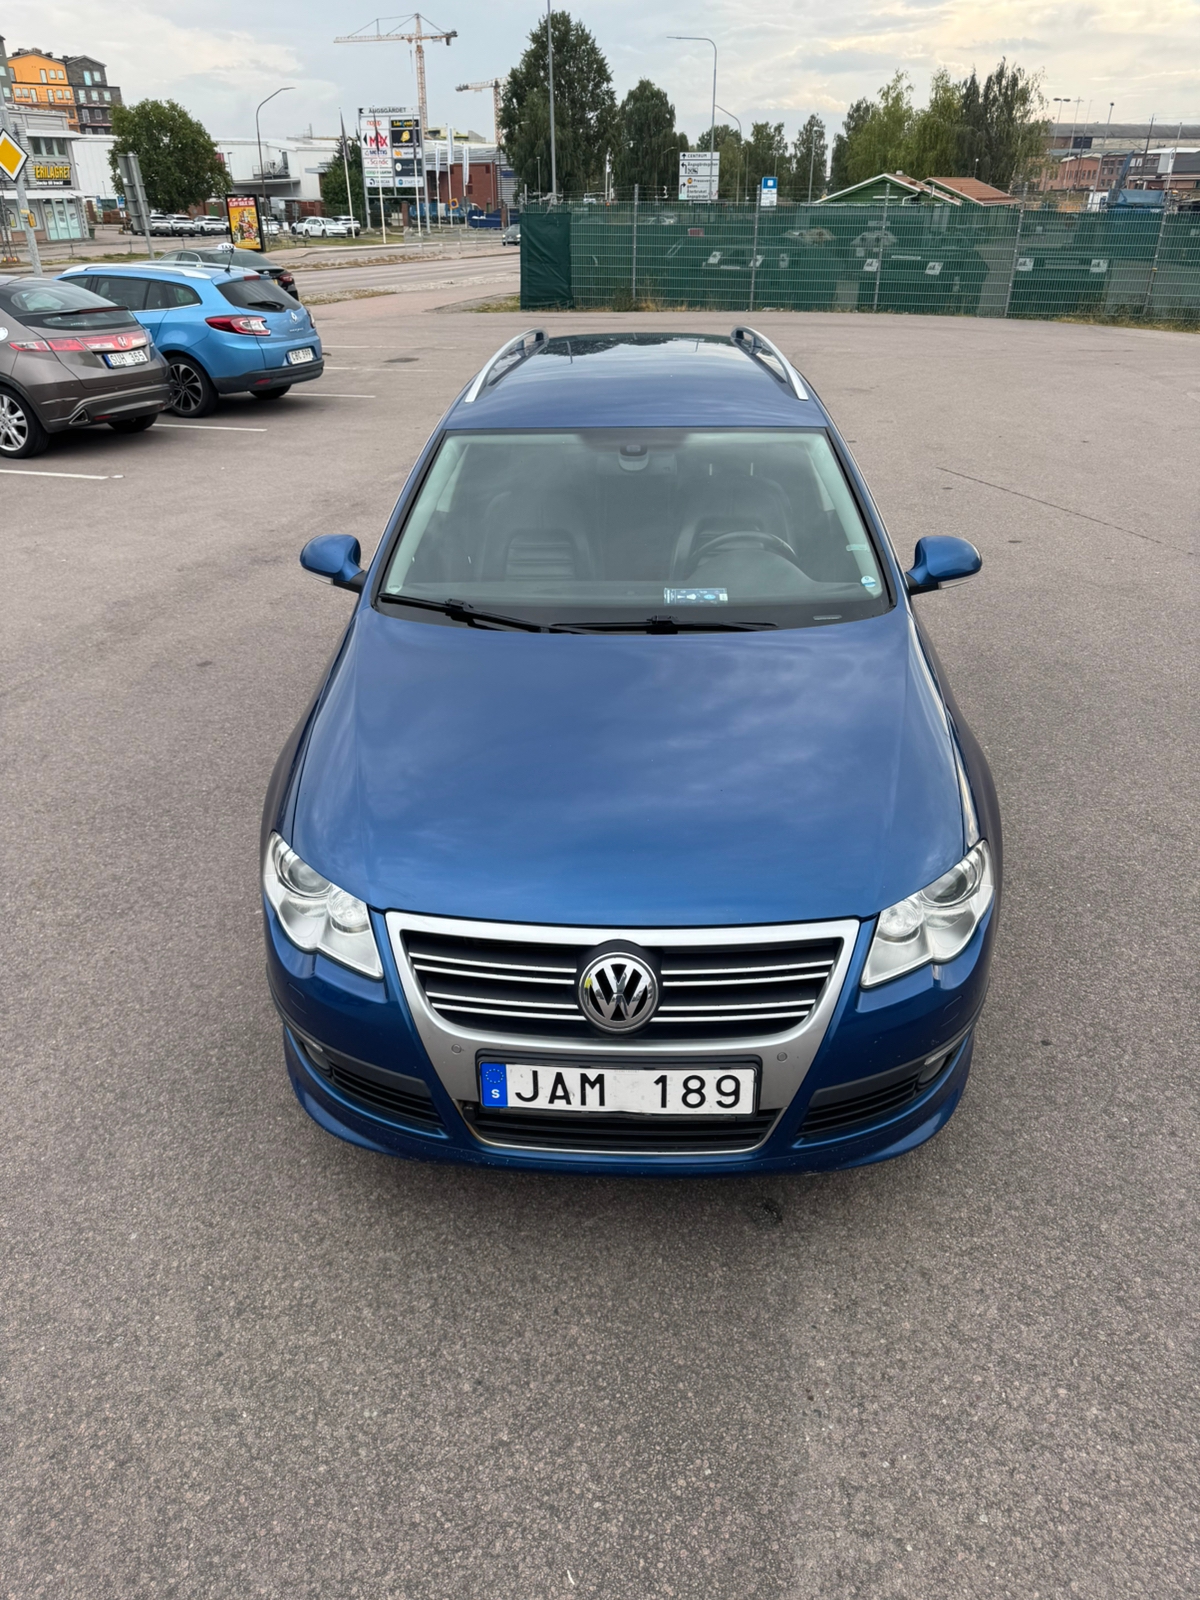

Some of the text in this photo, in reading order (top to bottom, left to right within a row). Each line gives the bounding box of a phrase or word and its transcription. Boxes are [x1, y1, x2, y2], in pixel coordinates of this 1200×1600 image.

[491, 1070, 741, 1109] S JAM 189
